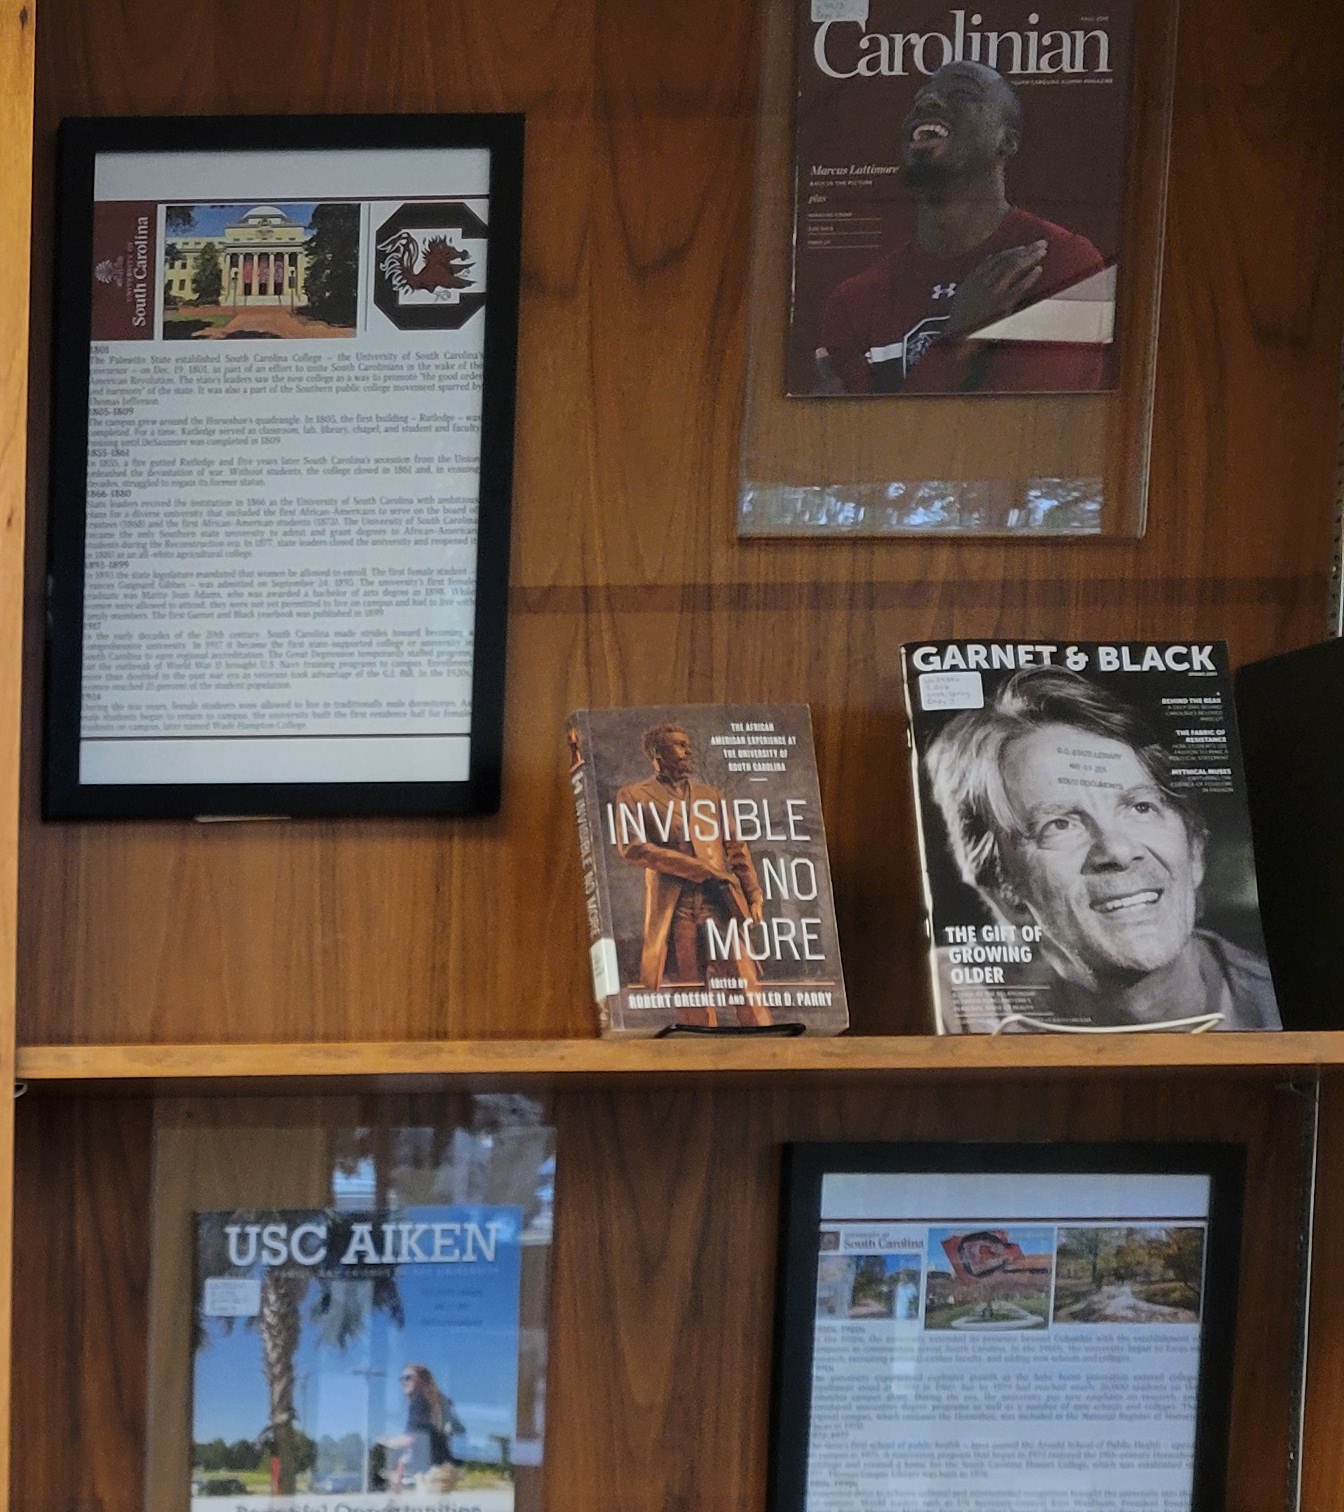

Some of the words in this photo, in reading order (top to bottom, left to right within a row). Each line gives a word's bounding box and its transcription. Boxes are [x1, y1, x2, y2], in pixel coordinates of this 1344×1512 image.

[814, 10, 1113, 78] Carolinian
[810, 165, 848, 175] Marcus
[850, 165, 899, 174] Lattimore
[134, 217, 149, 279] Carolina
[132, 283, 147, 326] South
[356, 352, 397, 362] University
[415, 351, 439, 360] South
[913, 645, 1057, 672] GARNET
[1066, 647, 1088, 672] &
[1099, 645, 1215, 671] BLACK
[731, 723, 744, 731] THE
[746, 722, 774, 731] AFRICAN
[711, 736, 746, 745] AMERICAN
[747, 736, 786, 745] EXPERIENCE
[788, 736, 796, 745] AT
[723, 749, 736, 758] THE
[738, 749, 777, 758] UNIVERSITY
[780, 749, 787, 758] OF
[728, 763, 751, 771] SOUTH
[753, 762, 786, 771] CAROLINA
[606, 799, 812, 845] INVISIBLE
[762, 858, 818, 900] NO
[706, 917, 826, 961] MORE
[946, 926, 976, 943] THE
[982, 926, 1016, 942] GIFT
[1021, 924, 1043, 941] OF
[949, 947, 1032, 963] GROWING
[711, 978, 736, 988] EDITED
[738, 977, 748, 988] BY
[951, 967, 1004, 984] OLDER
[629, 993, 672, 1008] ROBERT
[674, 993, 716, 1008] GREENE
[728, 995, 745, 1006] AND
[747, 992, 782, 1007] TYLER
[797, 992, 832, 1006] PARRY
[225, 1223, 327, 1267] USC
[341, 1222, 498, 1265] AIKEN
[843, 1237, 877, 1250] South
[879, 1237, 924, 1250] Carolina
